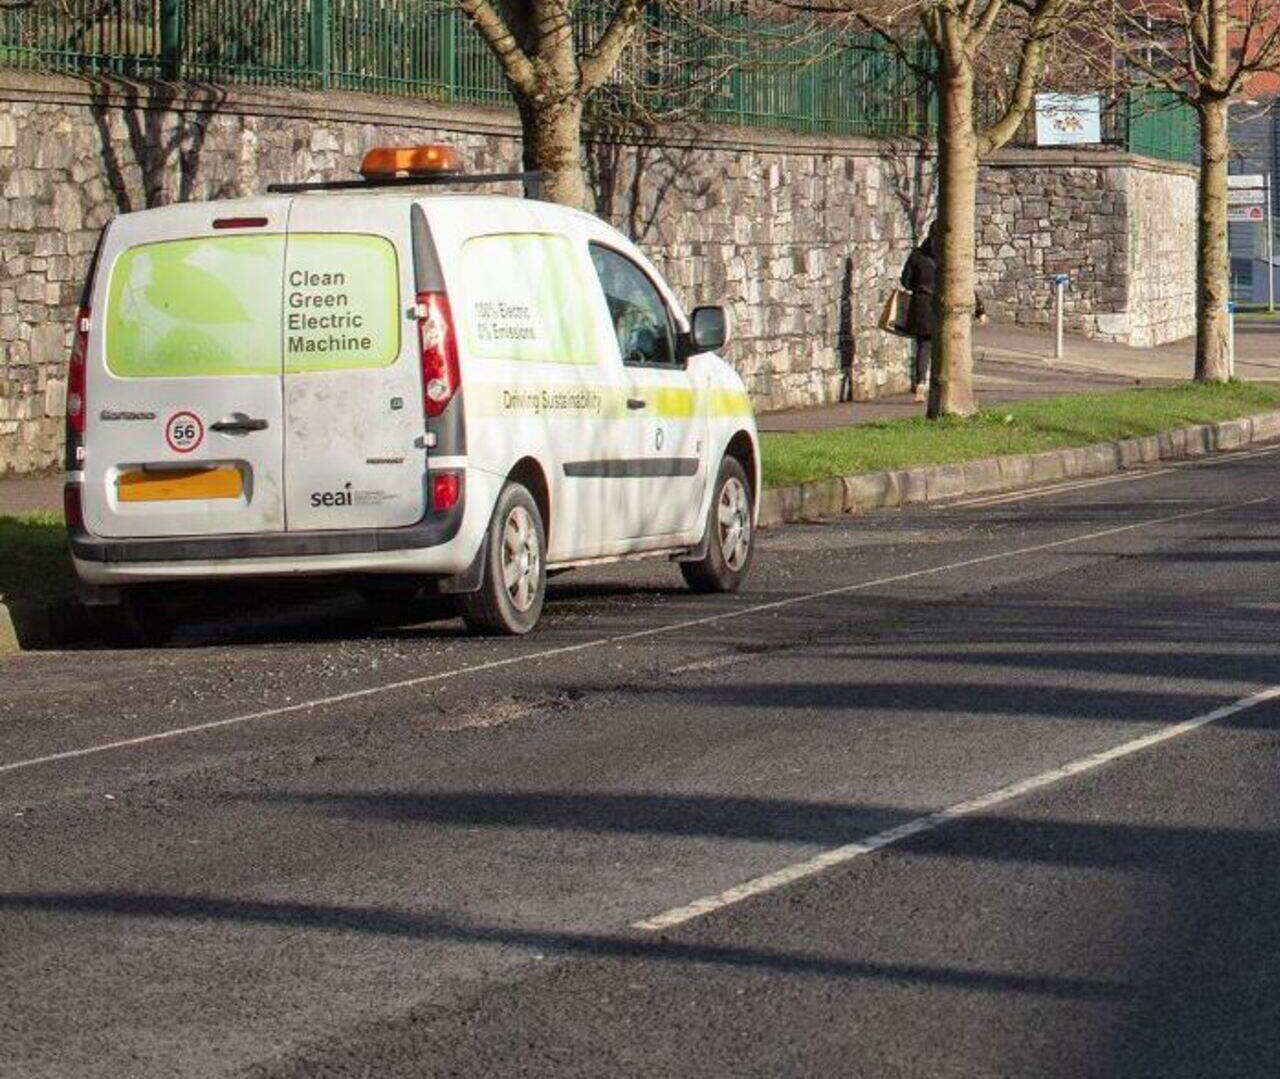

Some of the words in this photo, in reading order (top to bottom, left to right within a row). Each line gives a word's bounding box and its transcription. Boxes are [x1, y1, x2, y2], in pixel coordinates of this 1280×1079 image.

[288, 270, 346, 287] Clean
[288, 291, 349, 308] Green
[288, 311, 364, 331] Electric
[288, 334, 373, 353] Machine
[503, 390, 541, 414] Driving
[542, 390, 602, 414] Sustainability
[173, 423, 196, 440] 56
[310, 482, 353, 508] seai
